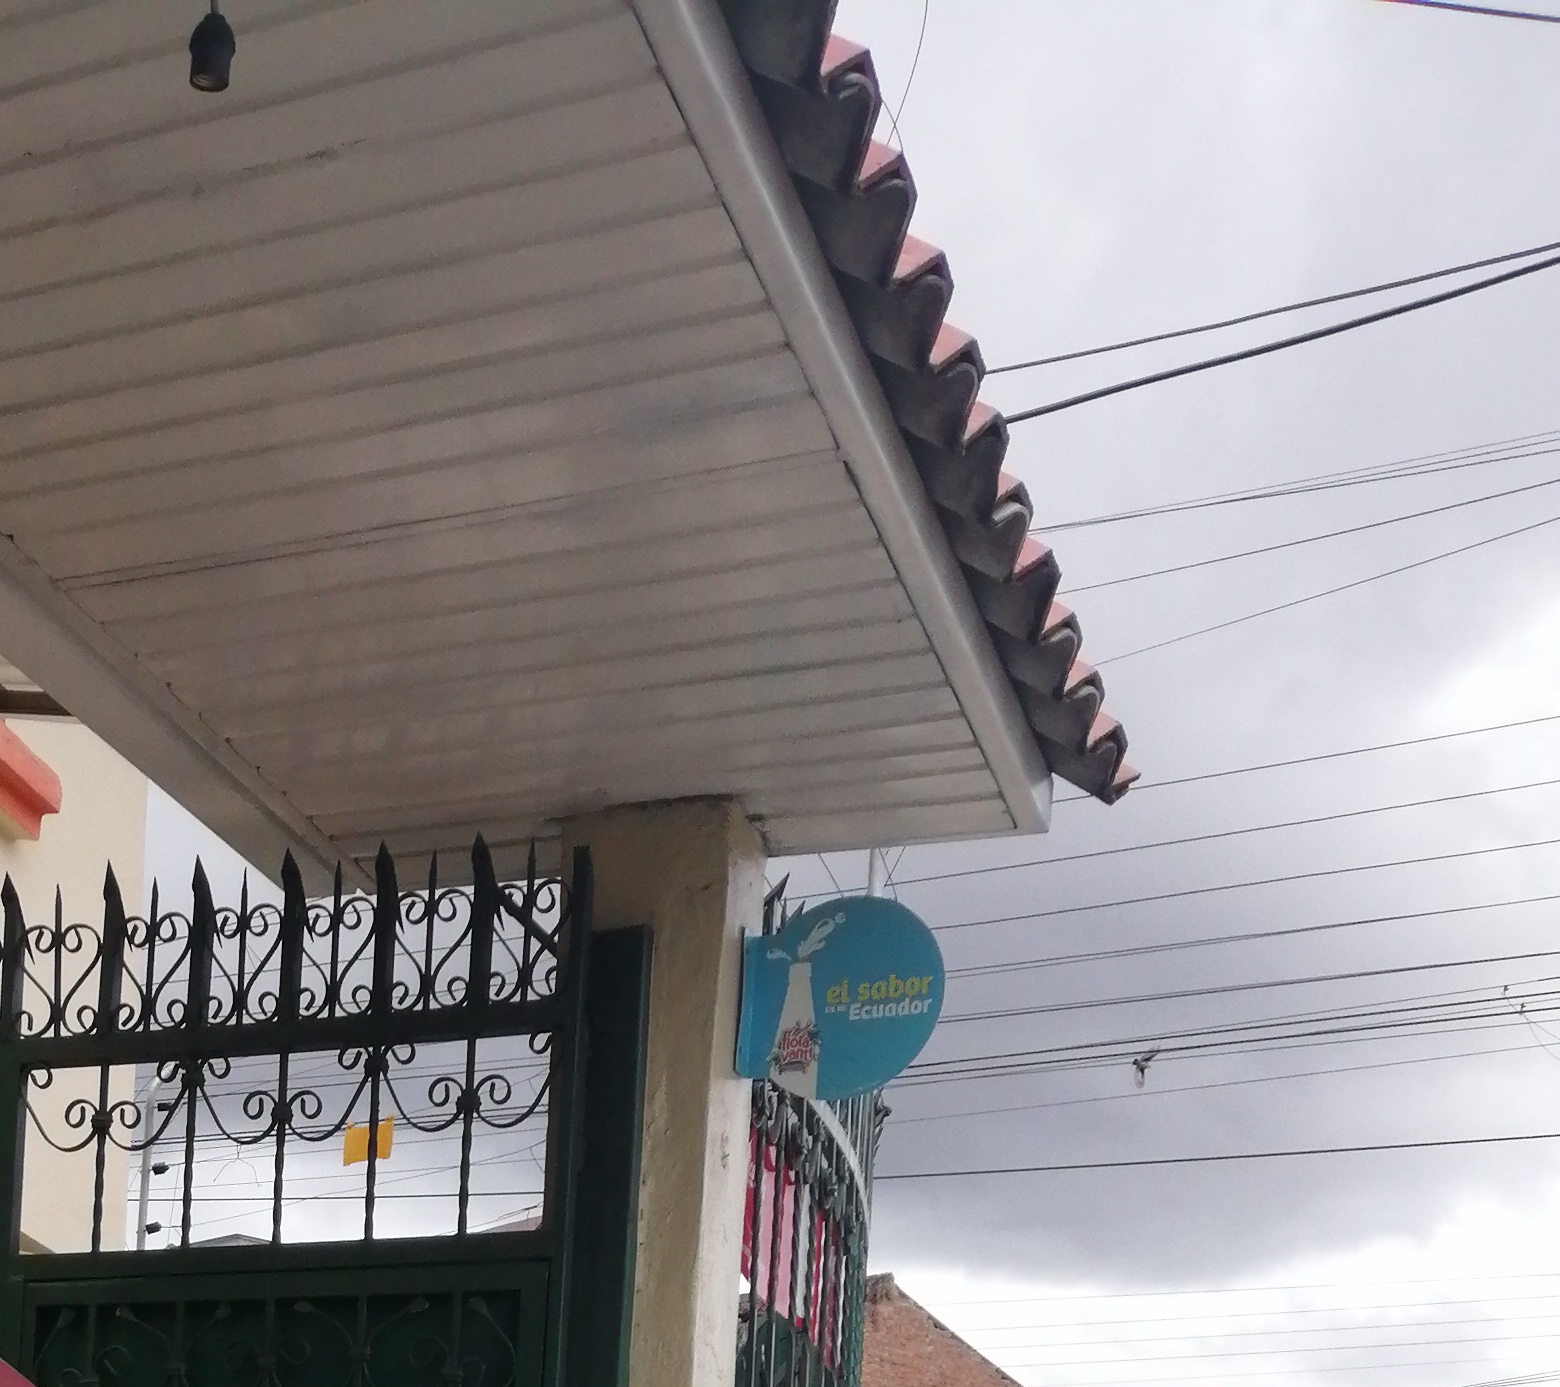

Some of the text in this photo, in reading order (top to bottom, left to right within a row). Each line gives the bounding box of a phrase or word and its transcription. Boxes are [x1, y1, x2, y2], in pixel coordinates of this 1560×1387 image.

[826, 974, 934, 1004] el sabor
[849, 996, 933, 1021] Ecuador
